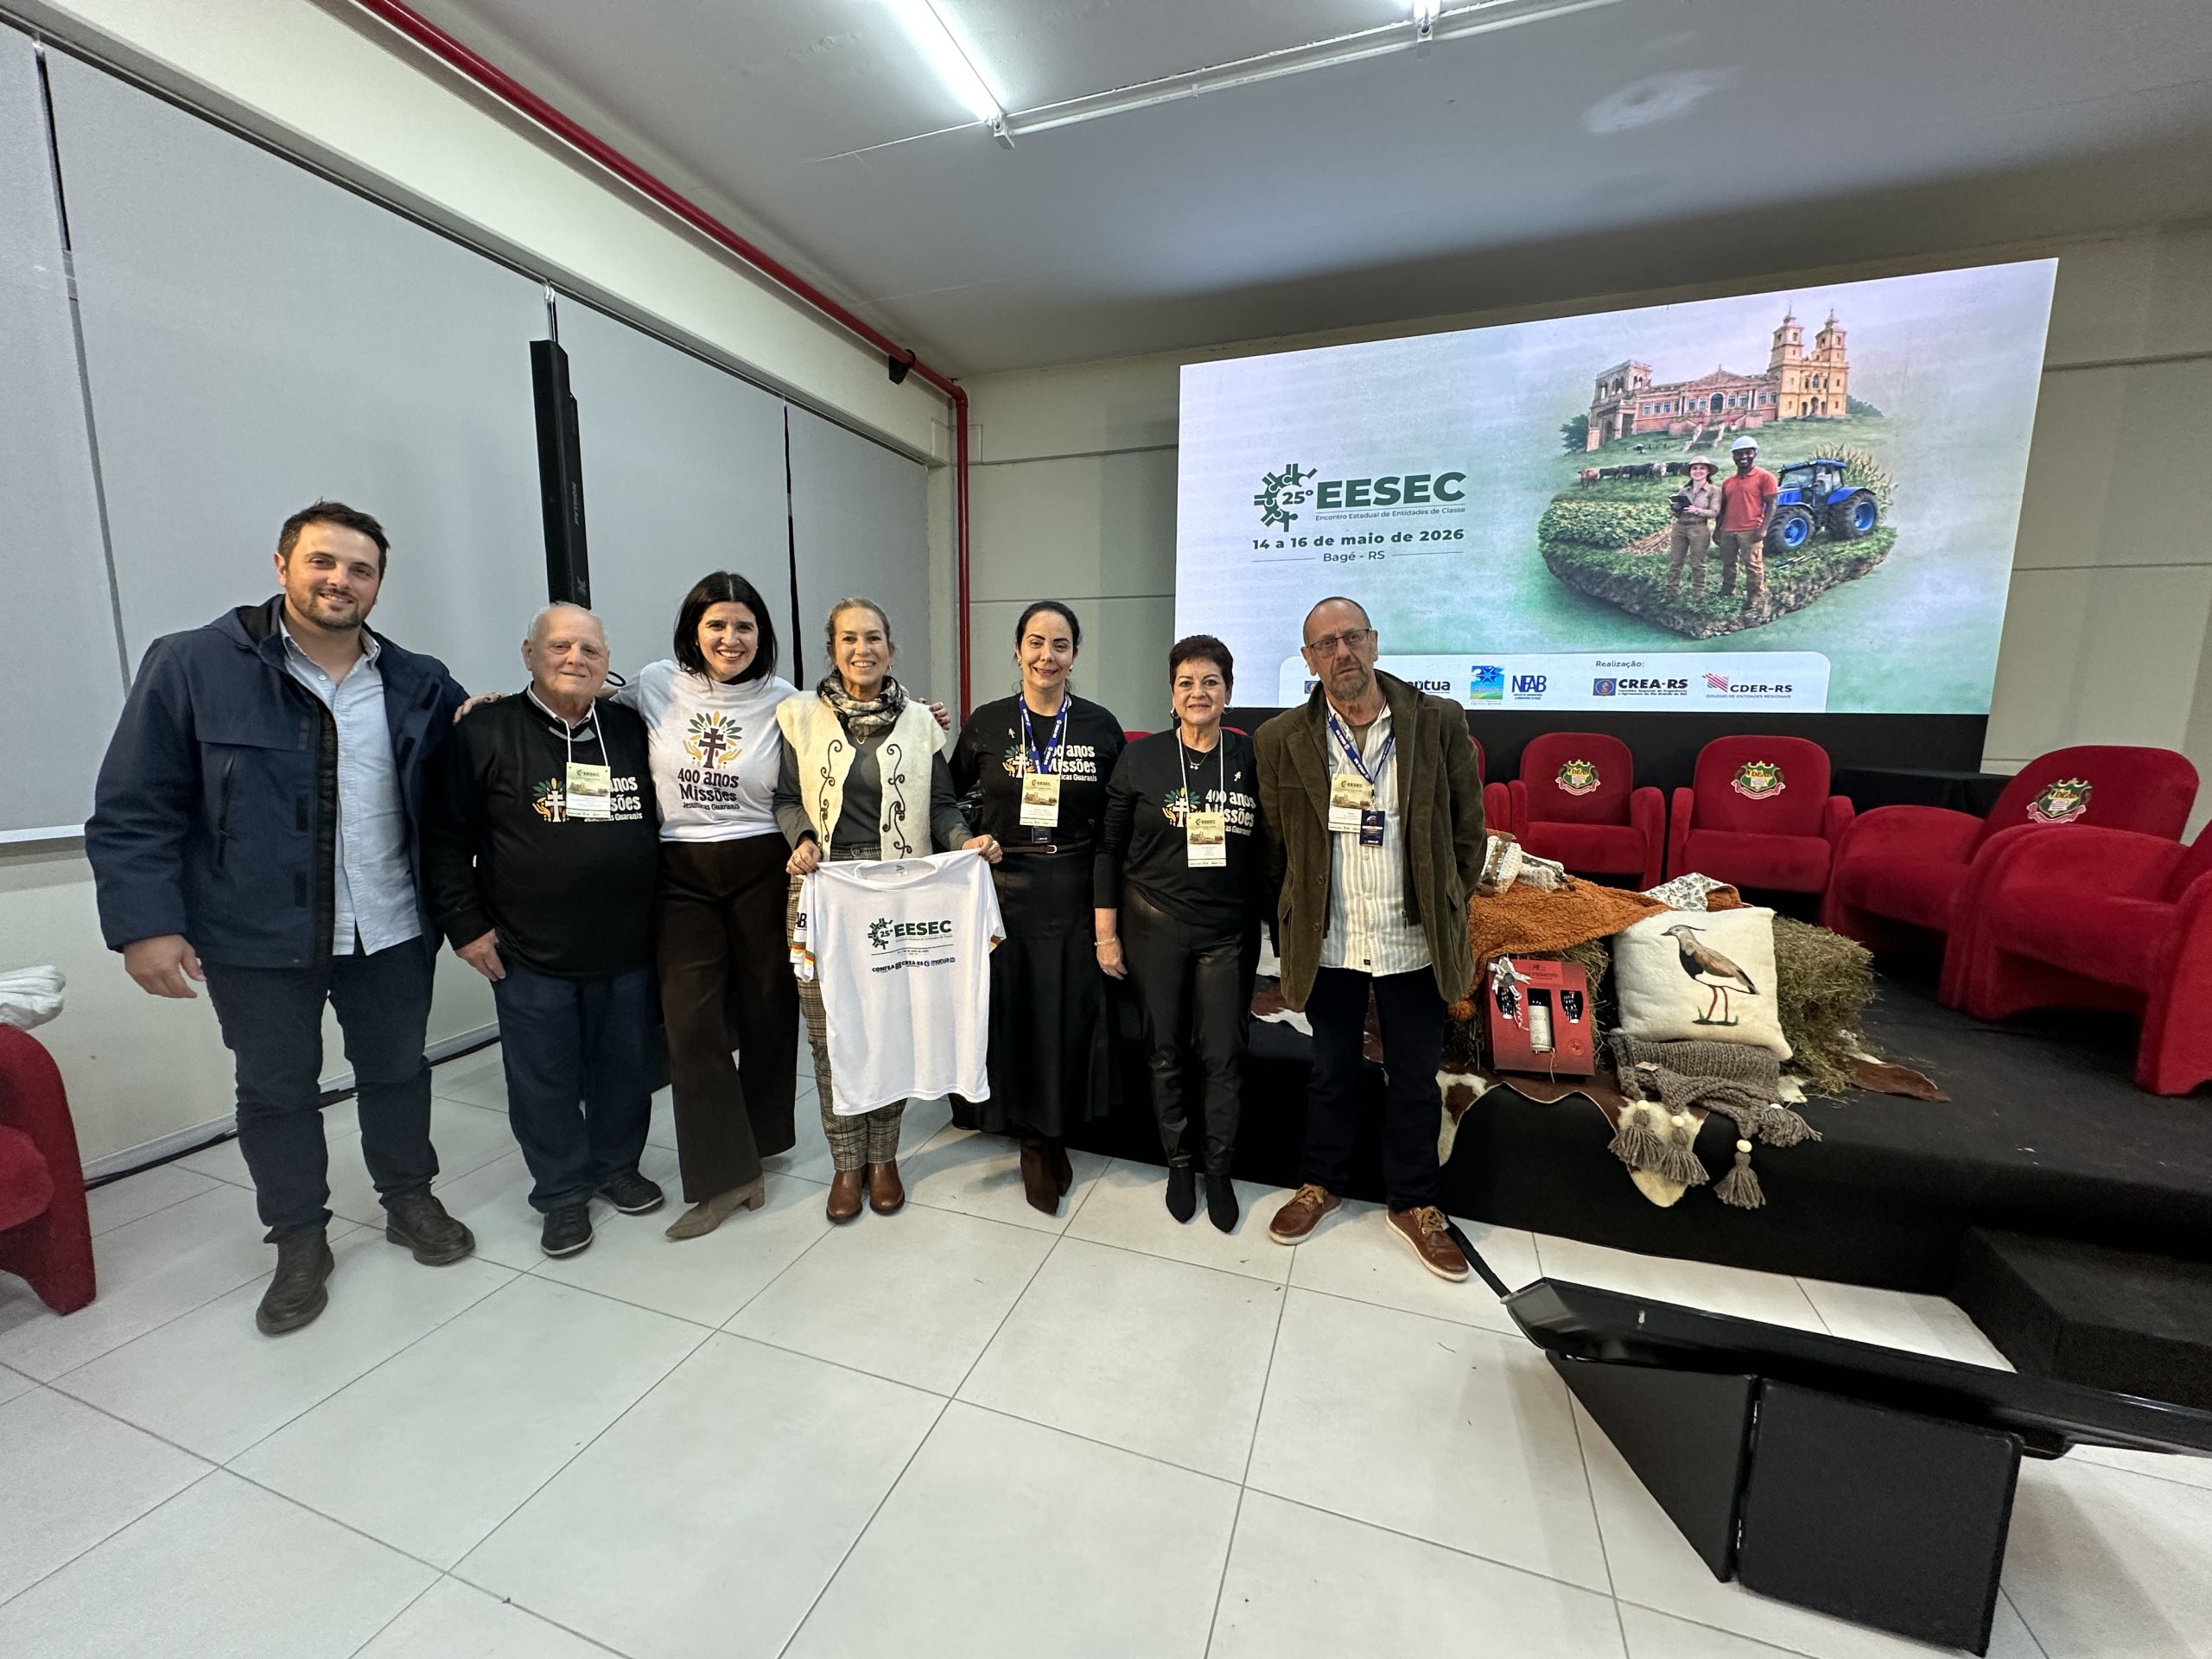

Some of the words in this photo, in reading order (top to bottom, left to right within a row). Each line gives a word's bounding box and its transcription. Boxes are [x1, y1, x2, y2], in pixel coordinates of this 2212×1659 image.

[1316, 472, 1466, 509] EESEC
[1392, 508, 1428, 517] Entidades
[1253, 539, 1269, 550] 14
[1291, 537, 1307, 548] 16
[1313, 536, 1334, 546] de
[1341, 532, 1384, 545] maio
[1391, 531, 1413, 543] de
[1419, 529, 1465, 542] 2026
[1324, 550, 1356, 563] Bagé
[1368, 550, 1385, 560] RS
[1596, 659, 1645, 669] Realização:
[1618, 678, 1688, 689] CREA-RS
[1730, 684, 1793, 693] CDER-RS
[1066, 745, 1096, 758] anos
[610, 777, 638, 792] nos
[677, 768, 701, 784] 400
[703, 772, 740, 788] anos
[678, 783, 737, 802] Missões
[1230, 791, 1256, 809] anos
[610, 794, 641, 811] sões
[894, 920, 952, 938] EESEC
